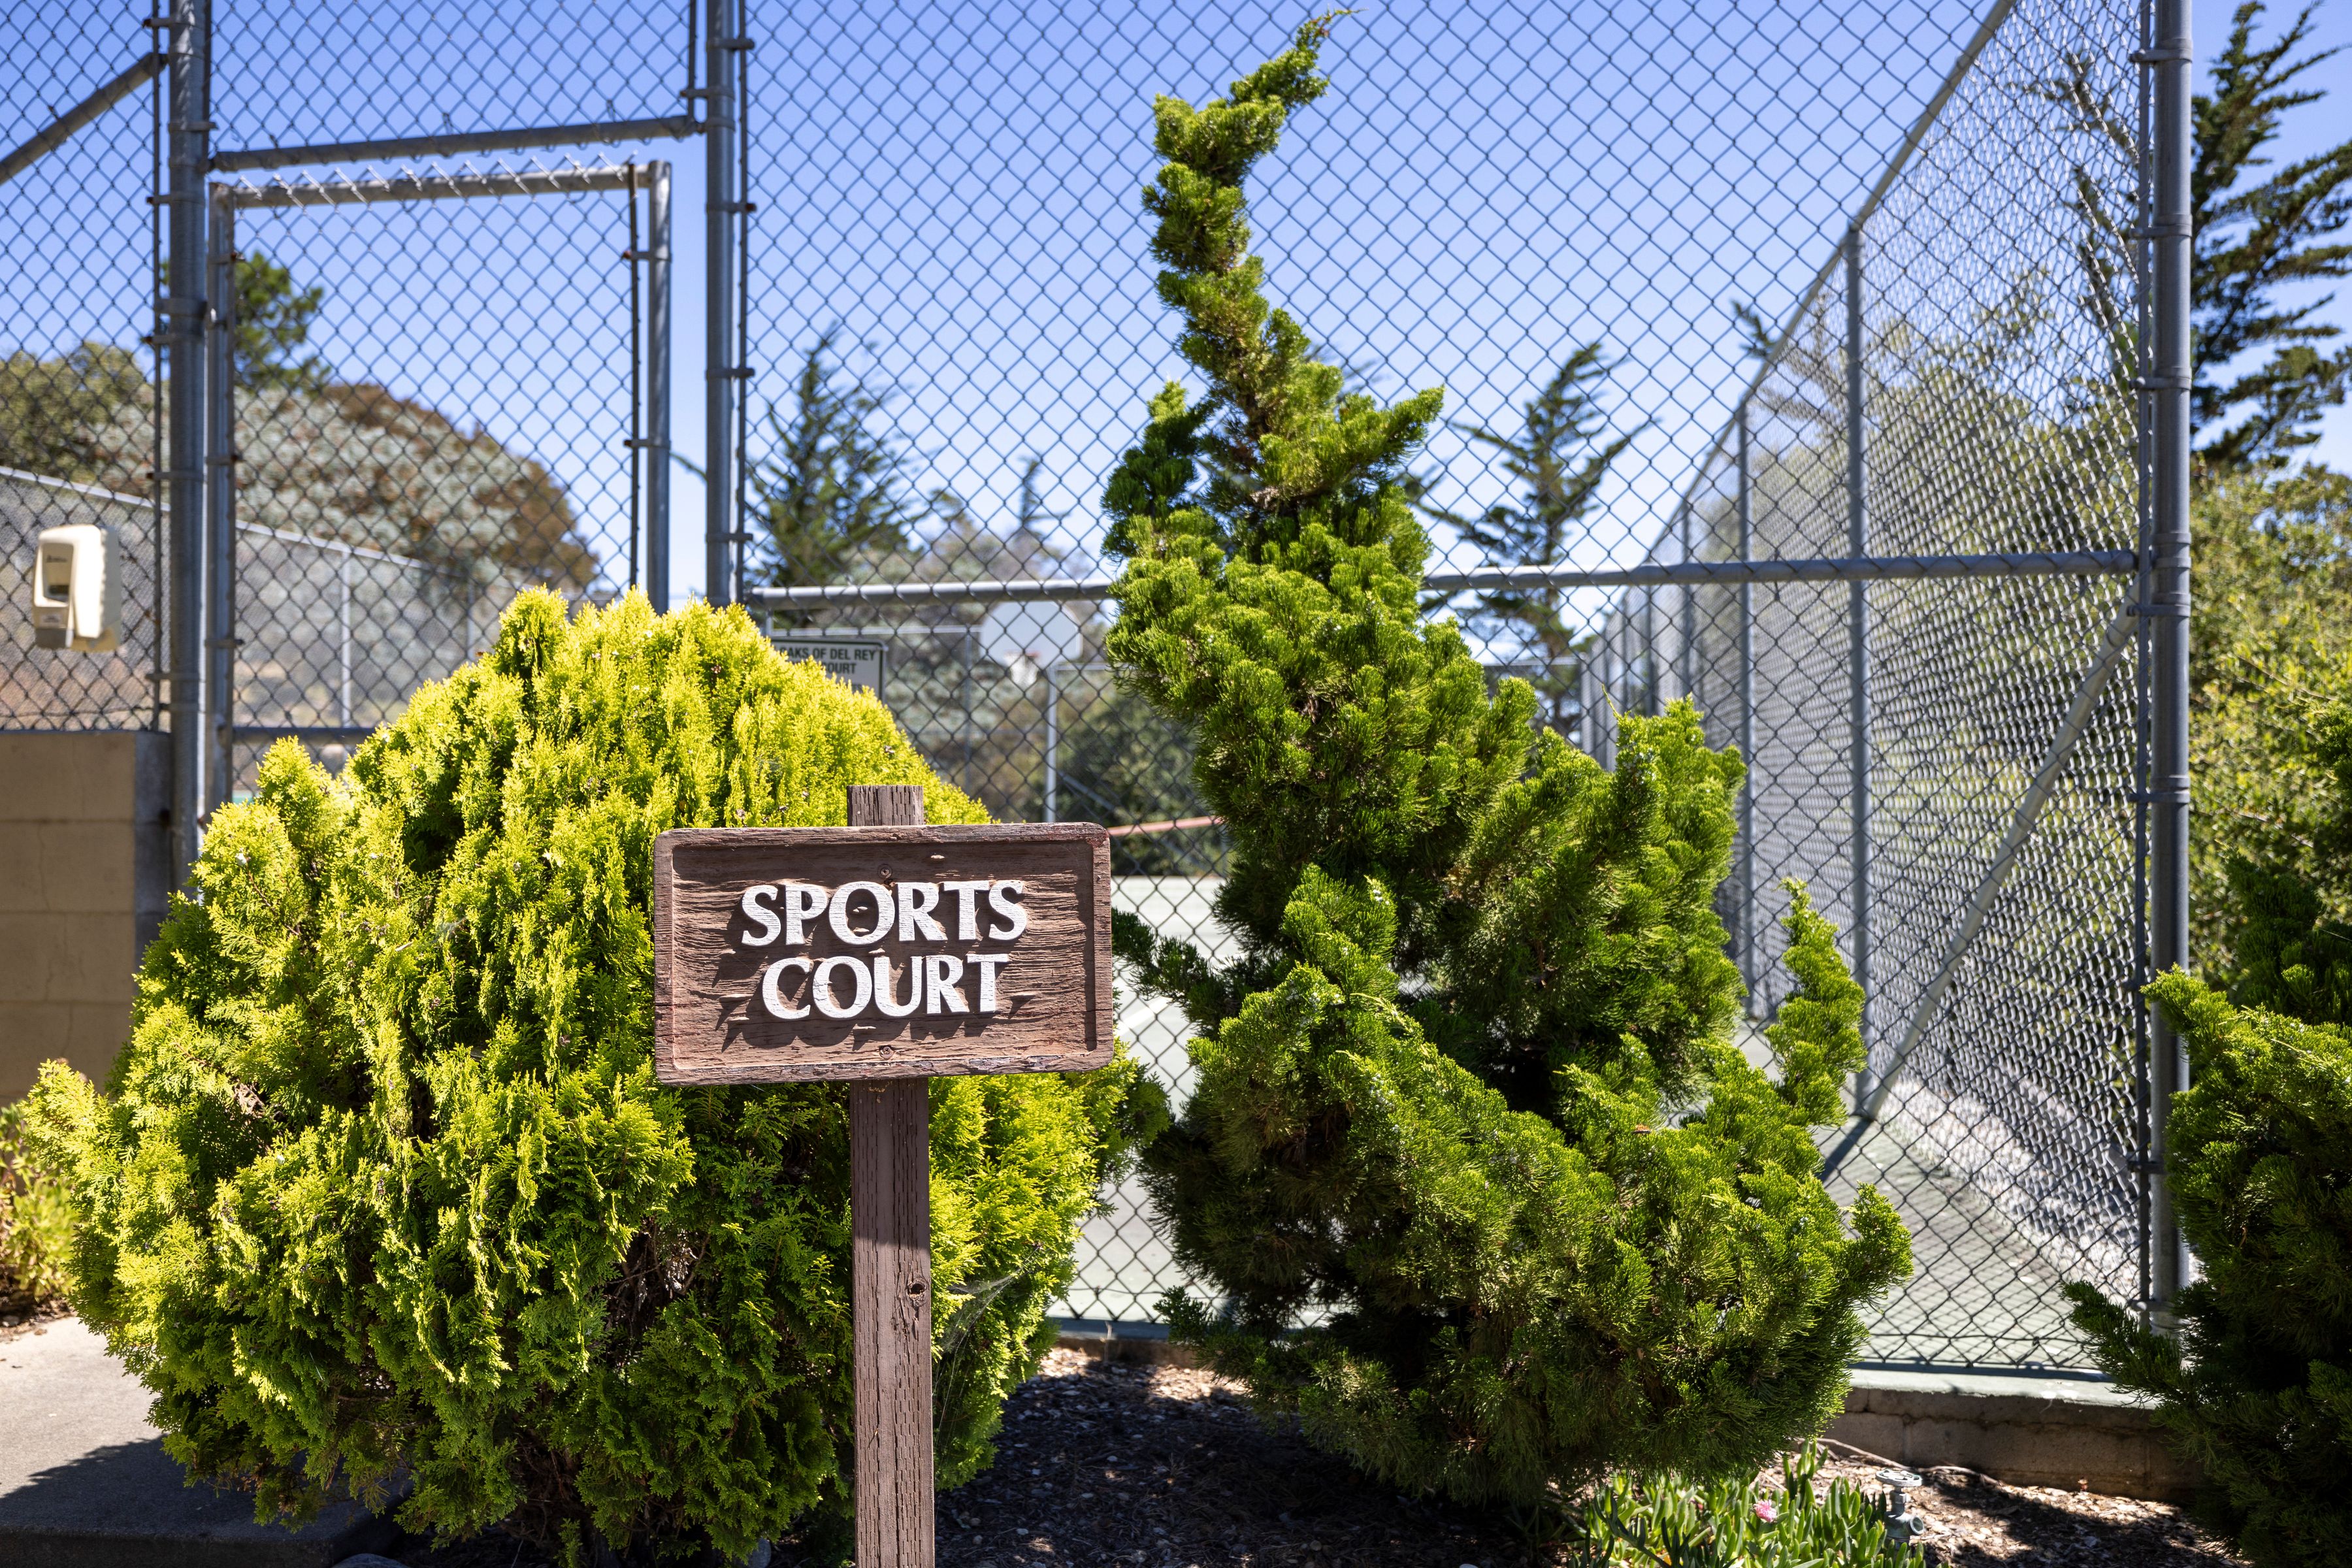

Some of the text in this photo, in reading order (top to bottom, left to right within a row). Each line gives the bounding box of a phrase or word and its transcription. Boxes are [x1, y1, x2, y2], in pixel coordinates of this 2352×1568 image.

[813, 647, 826, 659] OF
[830, 648, 851, 660] DEL
[854, 649, 875, 661] REY
[822, 662, 857, 674] OURT
[741, 880, 1028, 947] SPORTS
[762, 953, 1011, 1020] COURT
